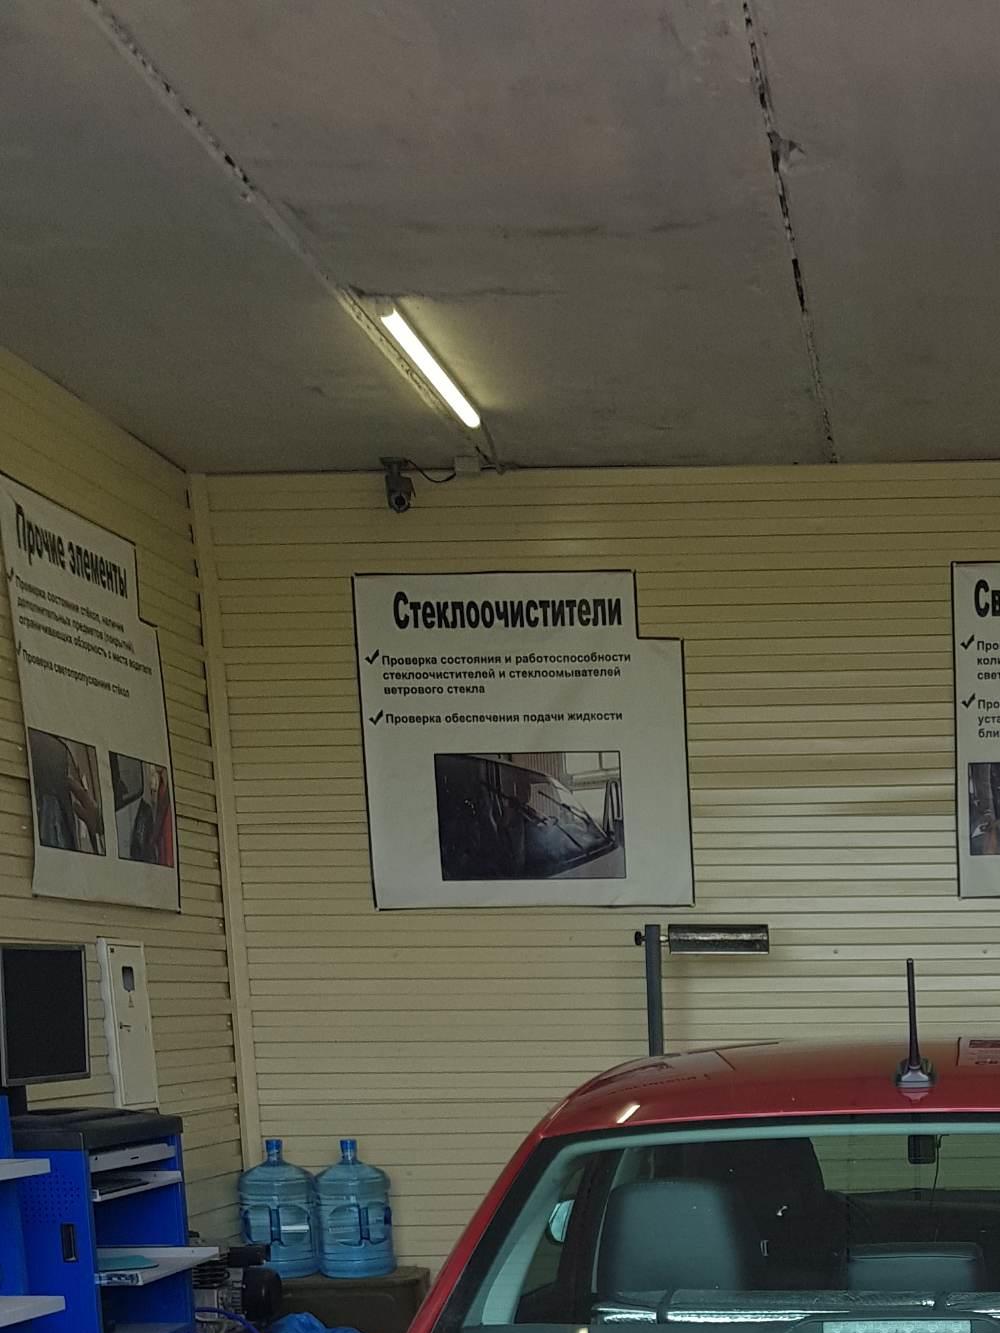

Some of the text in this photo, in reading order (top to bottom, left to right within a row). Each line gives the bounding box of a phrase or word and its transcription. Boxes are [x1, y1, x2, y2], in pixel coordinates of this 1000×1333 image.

[15, 502, 128, 599] Прочие элементы
[394, 592, 622, 629] Стеклоочистители
[382, 652, 630, 667] Проверка состояния и работоспособности
[383, 668, 495, 680] стеклоочистителей
[509, 666, 620, 678] стеклоомывателей
[384, 686, 485, 696] ветрового стекла
[386, 713, 622, 725] Проверка обеспечения подачи жидкости
